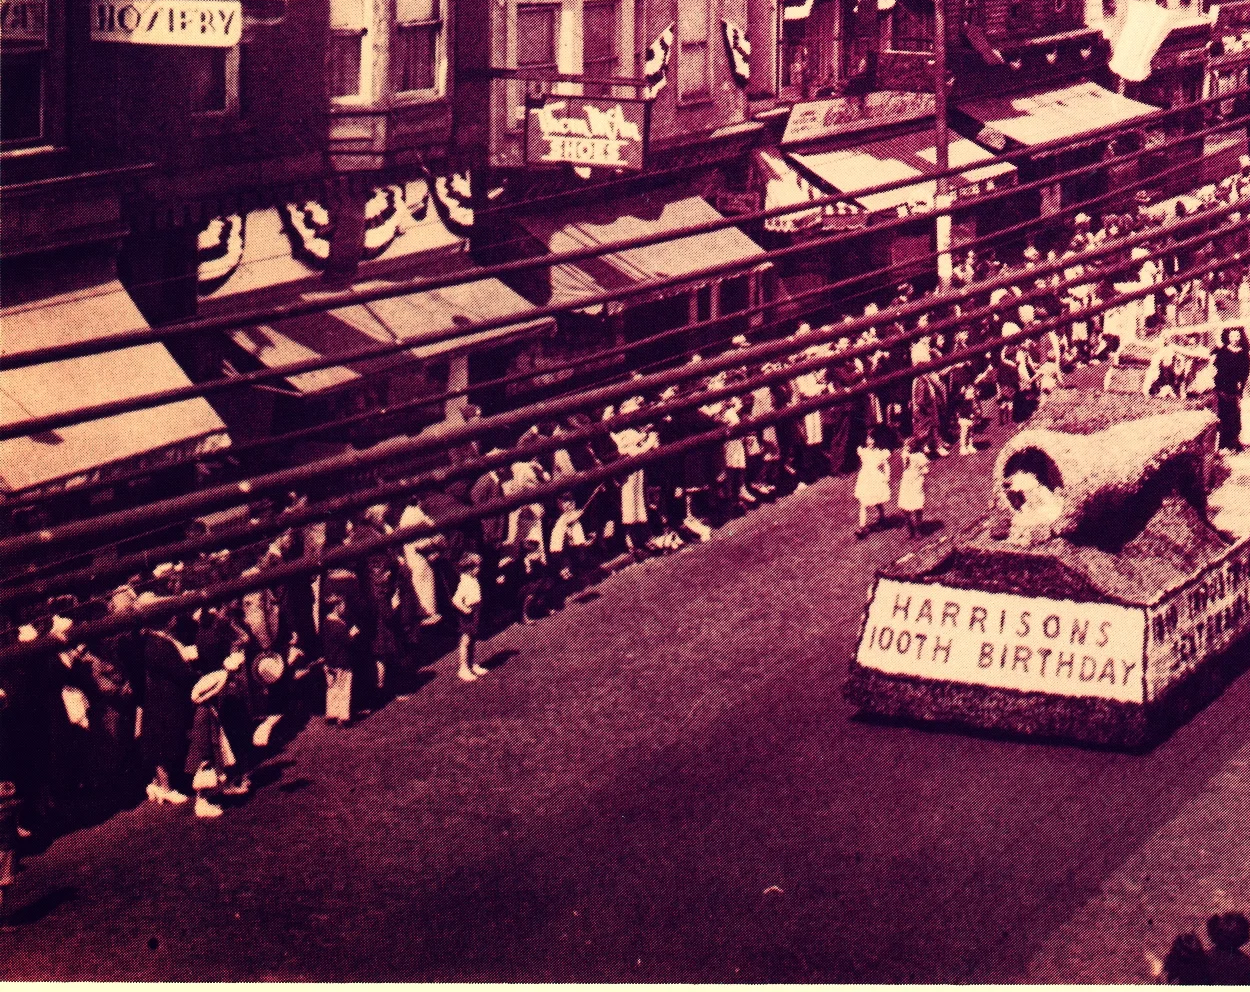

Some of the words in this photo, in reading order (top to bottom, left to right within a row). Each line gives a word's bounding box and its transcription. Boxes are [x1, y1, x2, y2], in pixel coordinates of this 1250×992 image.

[95, 3, 236, 36] HOSIERY
[549, 139, 620, 161] SHOES
[892, 594, 1112, 648] HARRISONS
[868, 626, 953, 664] 100TH
[977, 642, 1137, 686] BIRTHDAY
